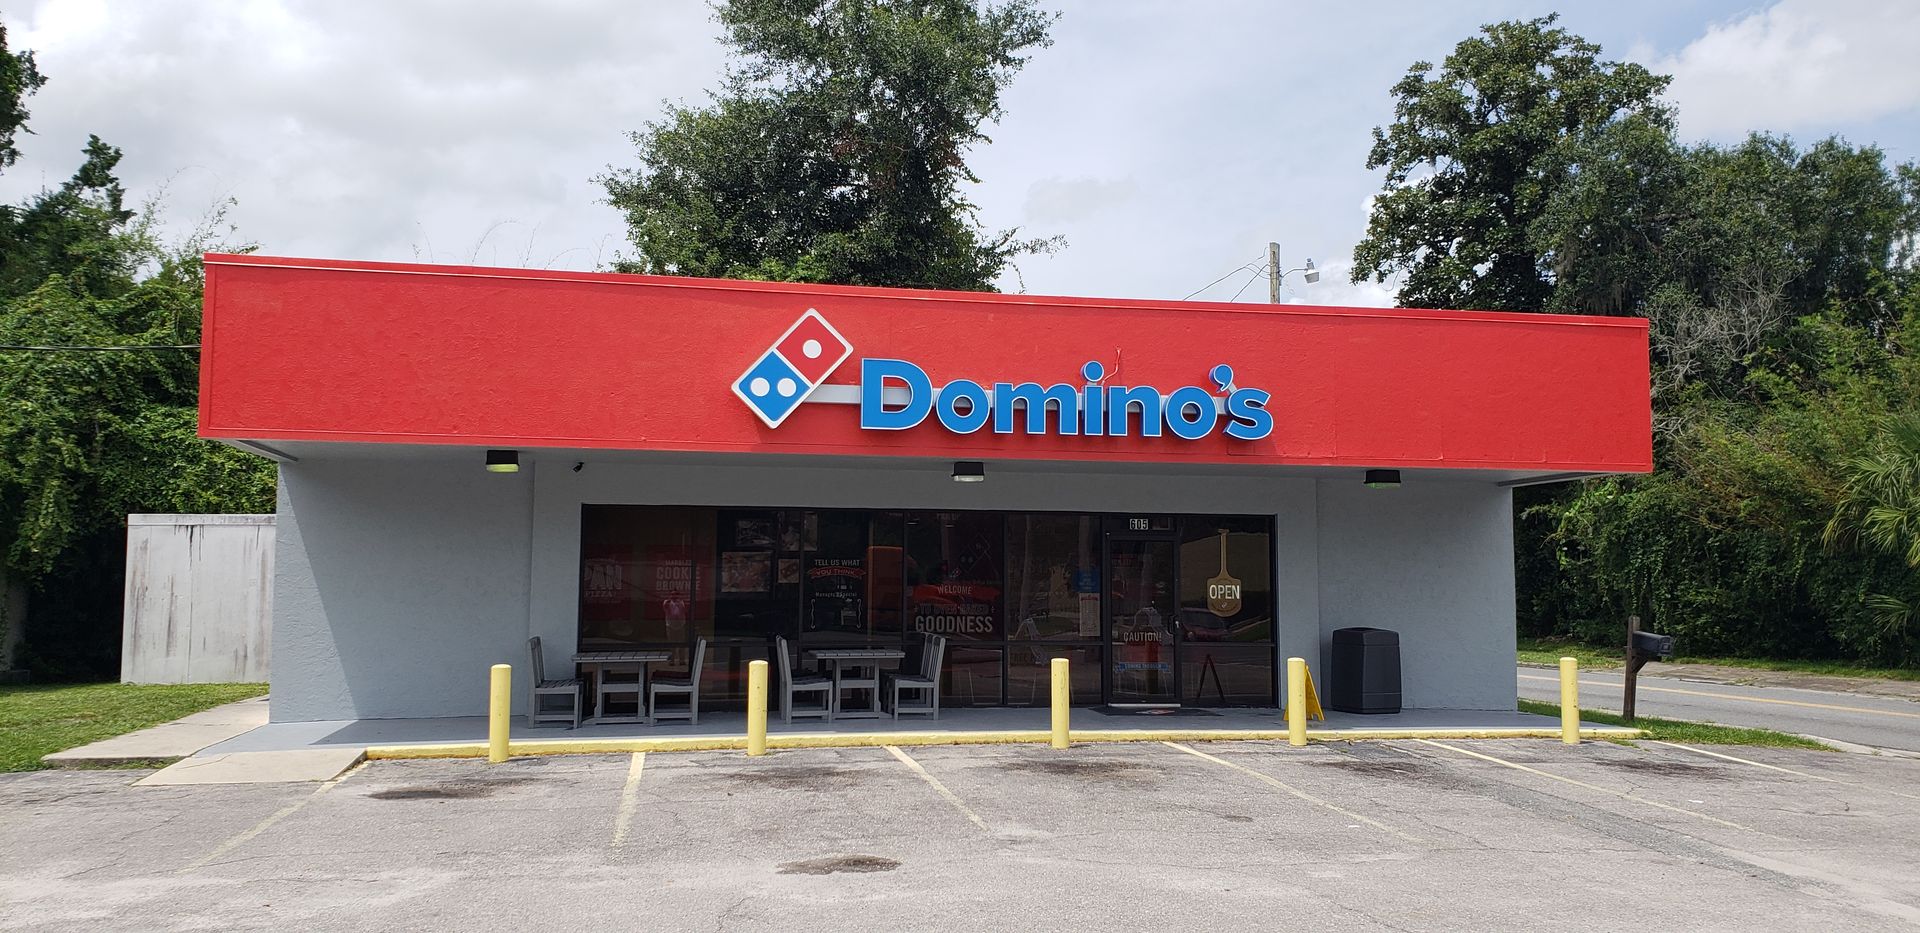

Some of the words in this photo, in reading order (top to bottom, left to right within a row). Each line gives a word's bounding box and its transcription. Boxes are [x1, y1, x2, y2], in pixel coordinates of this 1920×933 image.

[860, 357, 1274, 441] Domino's
[1130, 519, 1148, 530] 605
[656, 580, 701, 591] BROWNE
[937, 584, 973, 595] WELCOME
[1209, 584, 1240, 600] OPEN
[915, 615, 993, 633] GOODNESS
[1123, 631, 1162, 642] CAUTION!
